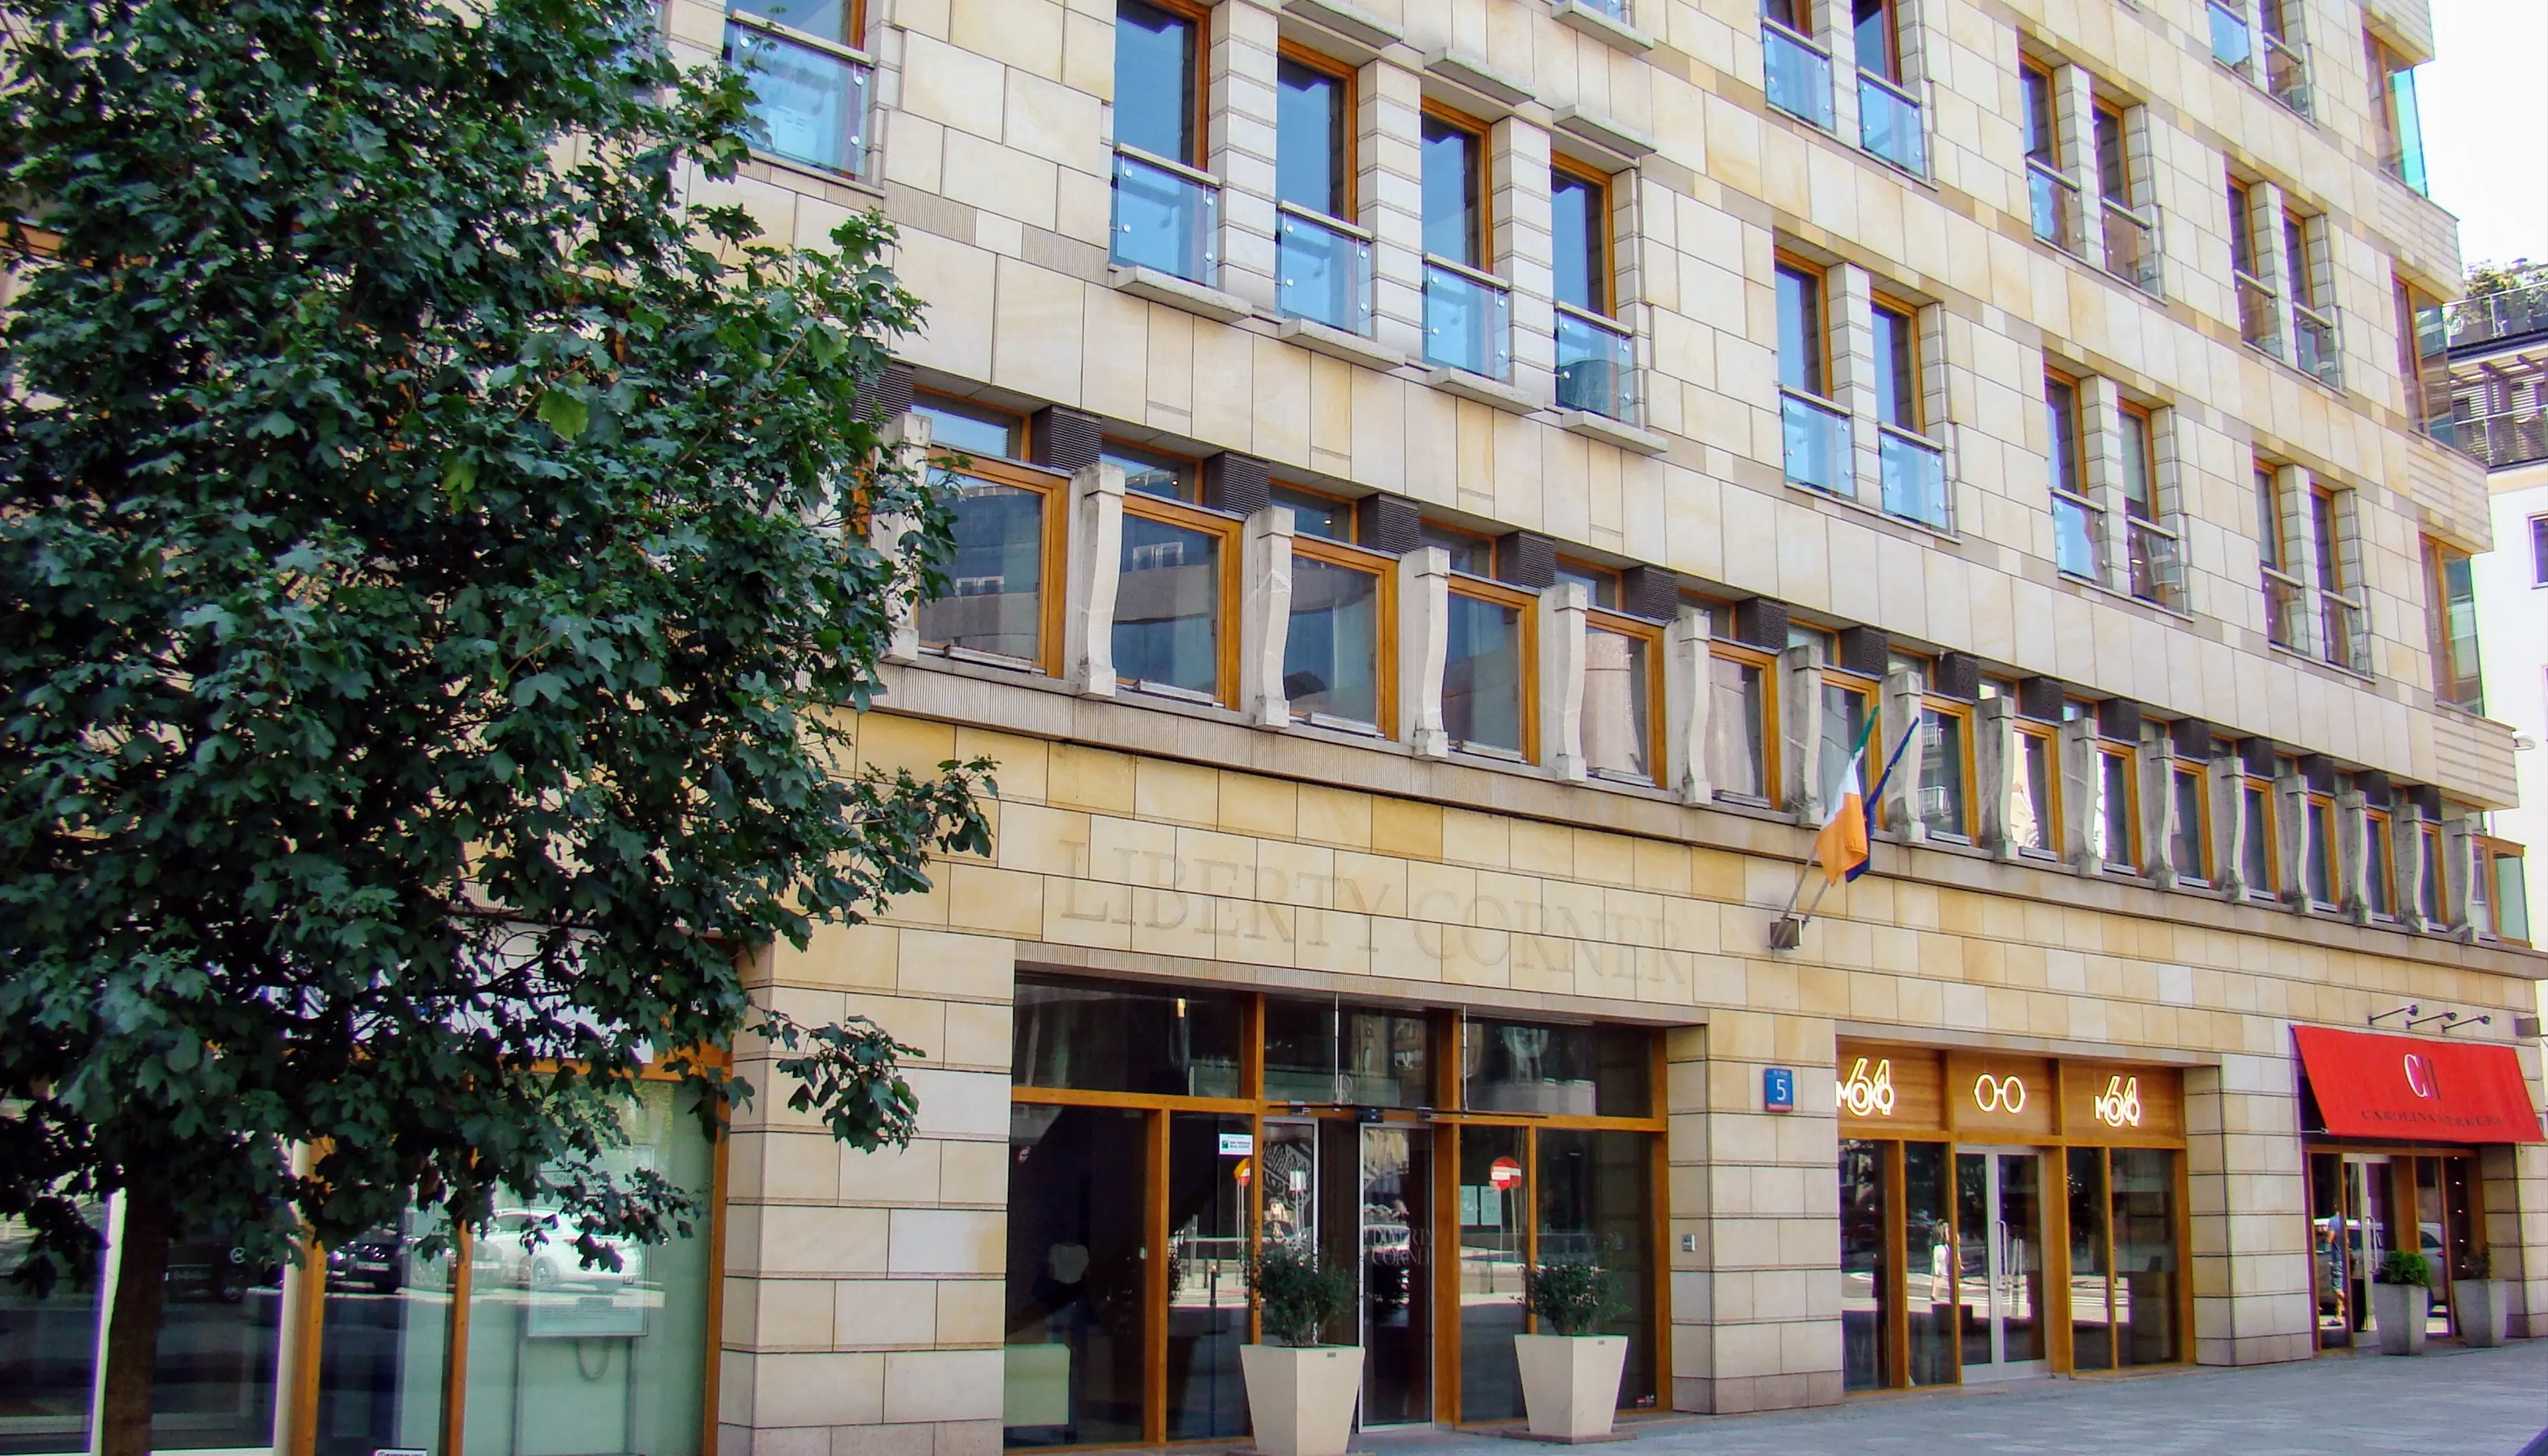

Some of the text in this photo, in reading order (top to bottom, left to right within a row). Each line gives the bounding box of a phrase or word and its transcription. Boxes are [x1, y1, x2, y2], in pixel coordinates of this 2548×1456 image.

[1058, 838, 1685, 985] LIBERTY CORNER
[1776, 1078, 1787, 1101] 5
